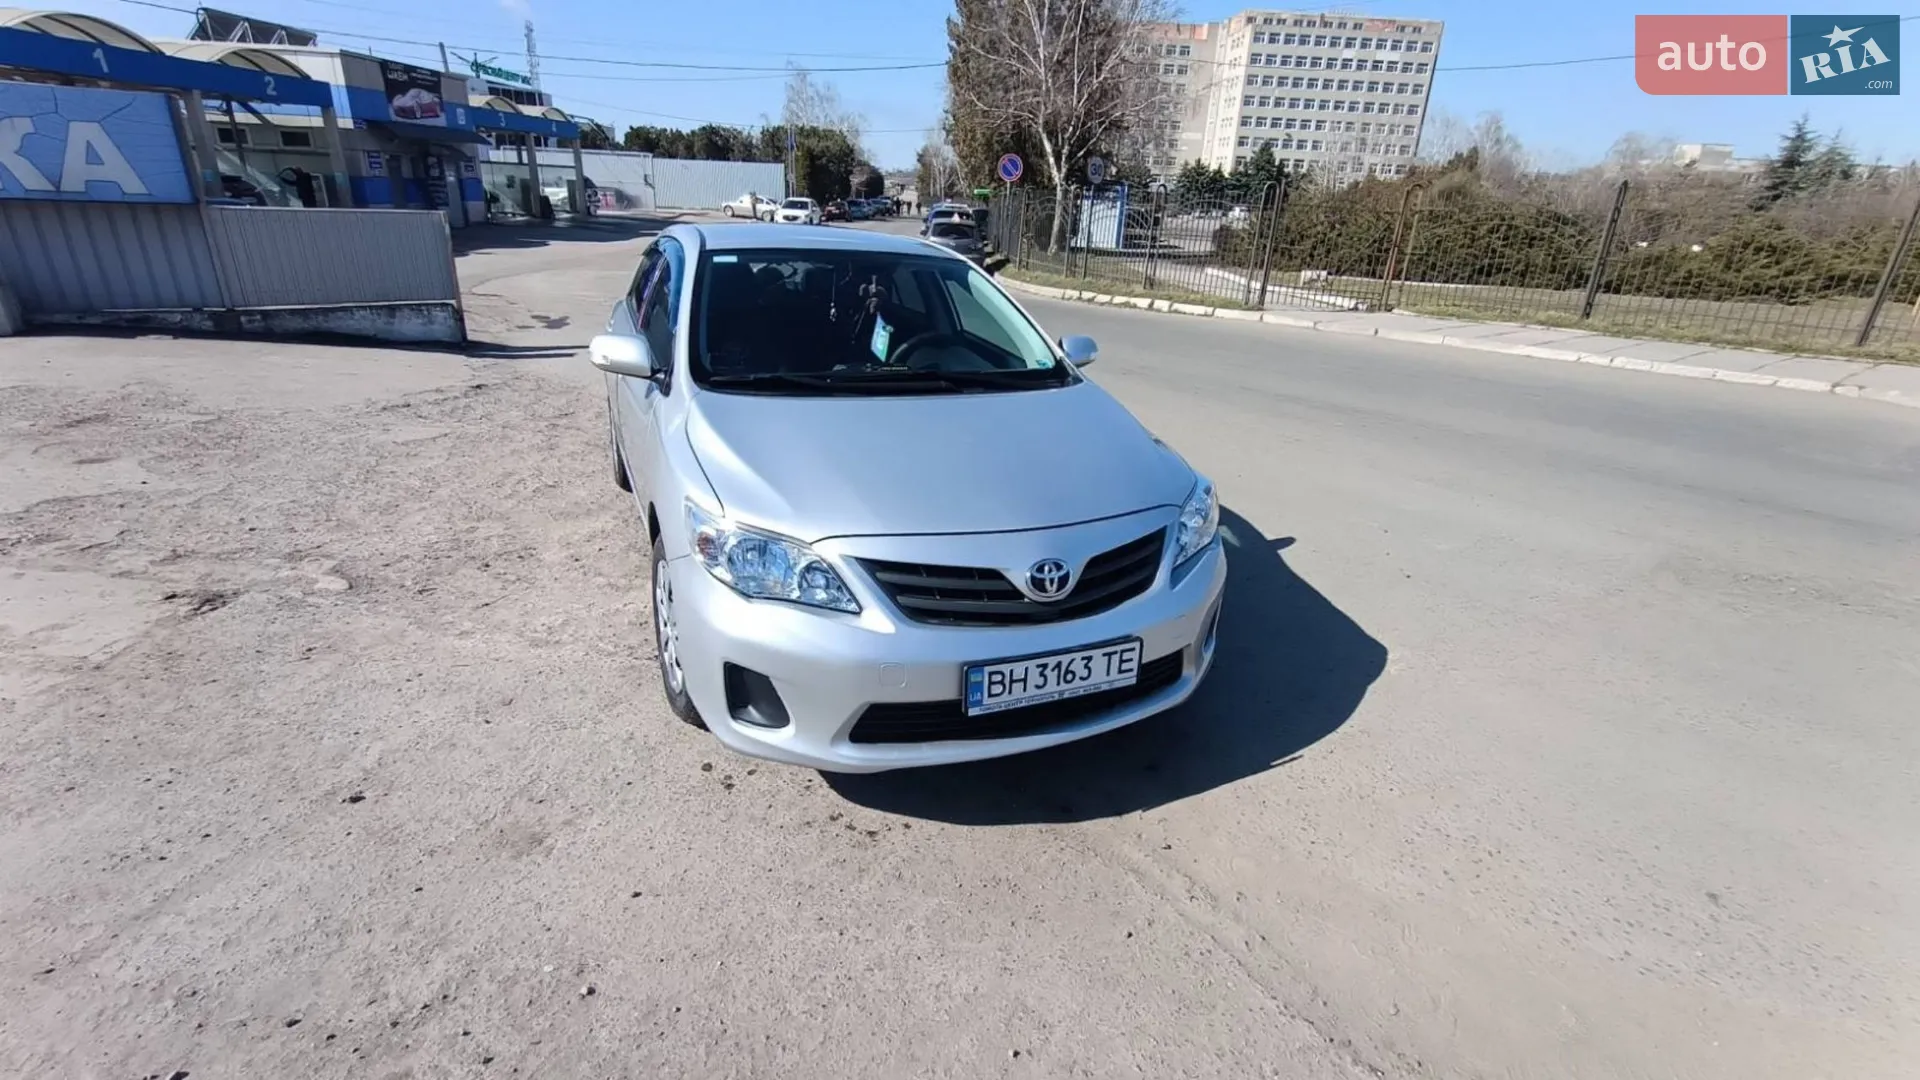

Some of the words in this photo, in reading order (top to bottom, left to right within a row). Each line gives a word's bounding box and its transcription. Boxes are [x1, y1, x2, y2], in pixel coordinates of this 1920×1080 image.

[92, 48, 109, 73] 1
[264, 76, 278, 96] 2
[498, 112, 506, 127] 3
[1091, 163, 1102, 176] 30
[987, 667, 1028, 699] BH
[1034, 656, 1092, 690] 3163
[1102, 648, 1135, 676] TE
[969, 692, 981, 701] UA
